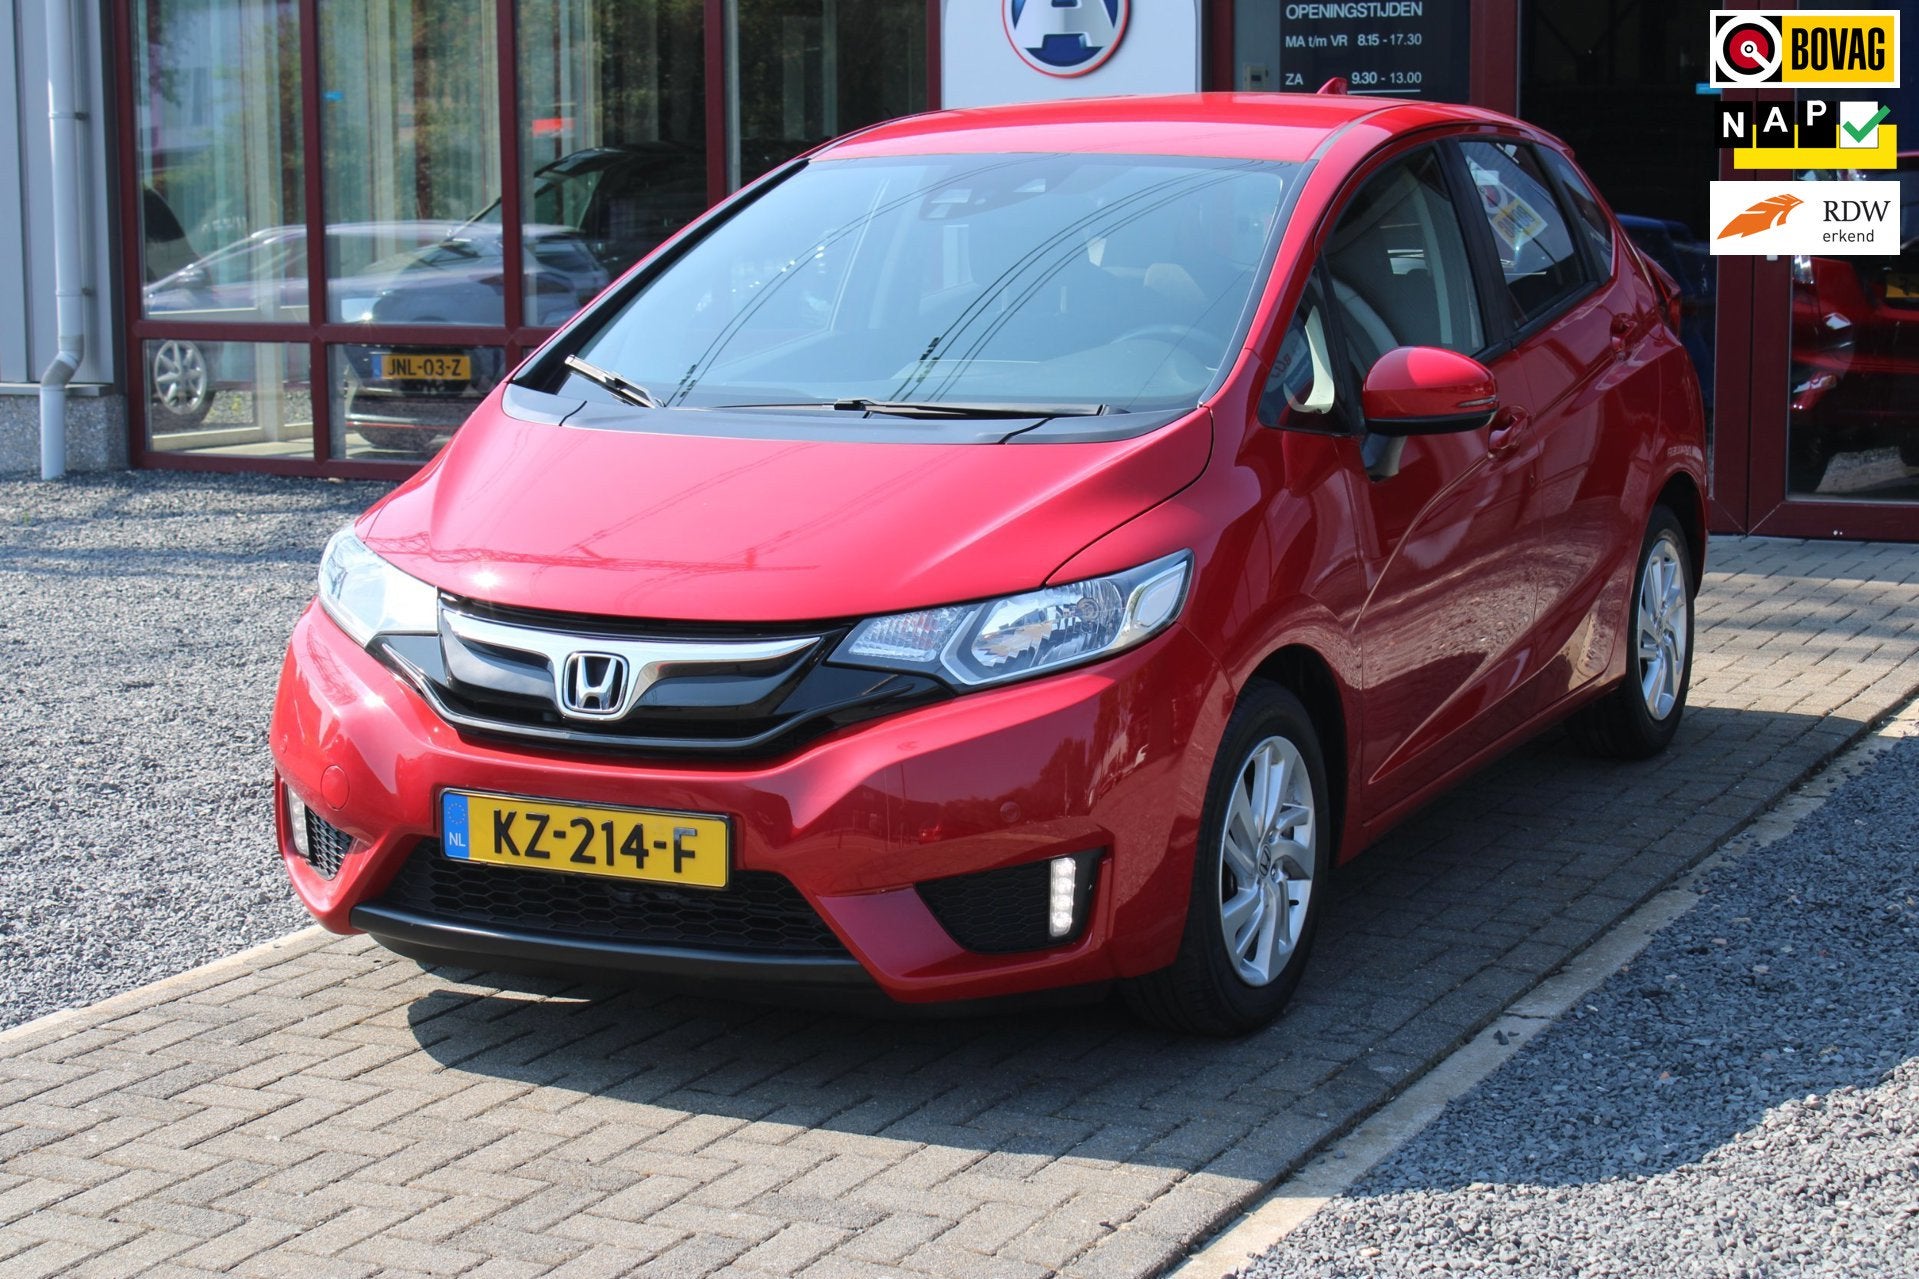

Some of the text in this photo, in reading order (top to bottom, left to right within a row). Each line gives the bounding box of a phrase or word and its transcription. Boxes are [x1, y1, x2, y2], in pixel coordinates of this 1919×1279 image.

[1285, 2, 1423, 19] OPENINGSTIJDEN
[1285, 36, 1305, 47] MA
[1308, 35, 1327, 47] t/m
[1330, 35, 1348, 46] VR
[1357, 34, 1379, 46] 8.15
[1390, 33, 1422, 45] 17.30
[1285, 73, 1303, 85] ZA
[1351, 72, 1377, 84] 9.30
[1390, 72, 1422, 84] 13.00
[388, 358, 461, 376] JNL-03-Z
[449, 809, 698, 873] NL KZ-214-F
